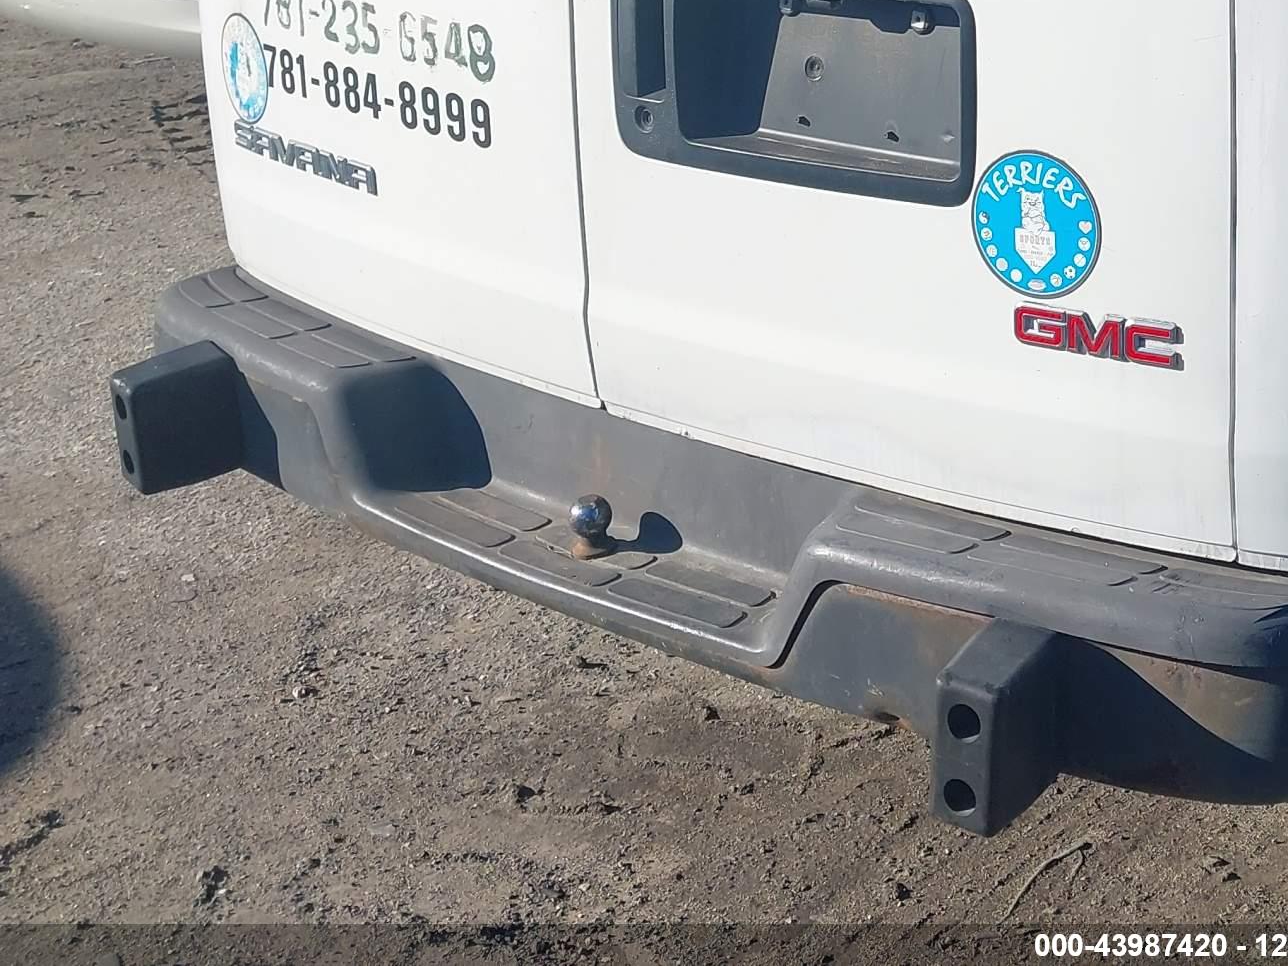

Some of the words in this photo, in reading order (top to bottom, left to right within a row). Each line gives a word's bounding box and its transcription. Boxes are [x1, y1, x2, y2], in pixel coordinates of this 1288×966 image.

[263, 43, 492, 149] 781-884-8999
[234, 119, 378, 196] SAVANA
[981, 160, 1087, 210] TERRIERS
[1013, 300, 1185, 372] GMC
